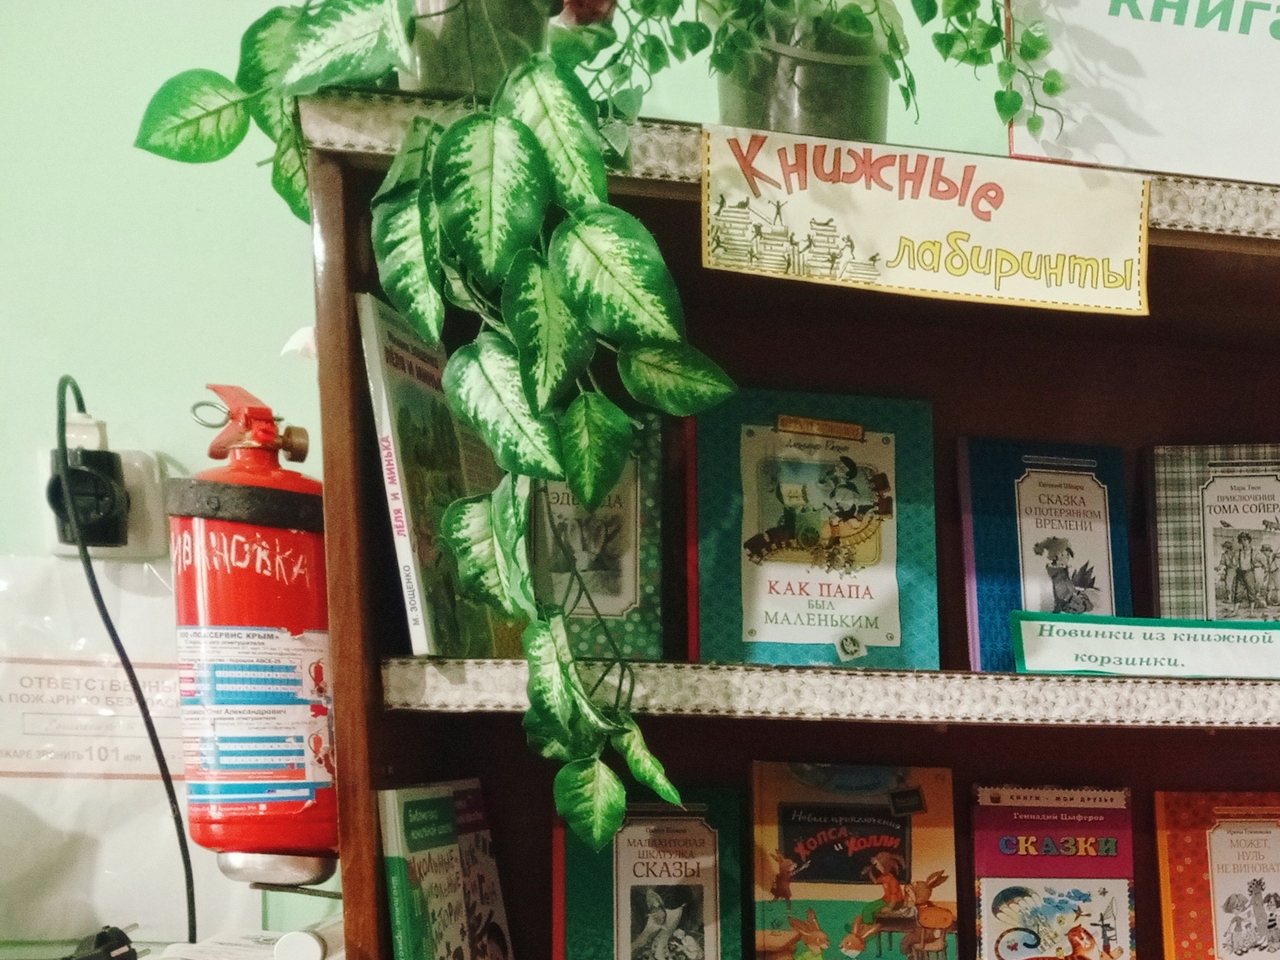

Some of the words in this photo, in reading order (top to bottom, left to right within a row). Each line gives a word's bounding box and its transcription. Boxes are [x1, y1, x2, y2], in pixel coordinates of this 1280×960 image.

[726, 133, 1005, 222] Книжные
[885, 230, 1135, 291] лабиринты
[380, 435, 398, 485] МИНЬКА
[391, 492, 400, 501] И
[1038, 494, 1086, 507] СКАЗКА
[1216, 494, 1275, 502] ПРИКЛЮЧЕНИЯ
[1025, 507, 1032, 515] О
[1034, 507, 1102, 519] ПОТЕРЯННОМ
[1206, 504, 1240, 515] ТОМА
[392, 508, 407, 537] ЛЁЛЯ
[1035, 519, 1093, 531] ВРЕМЕНИ
[403, 564, 419, 612] ЗОЩЕНКО
[767, 579, 811, 598] КАК
[818, 582, 874, 600] ПАПА
[807, 600, 835, 612] БЫЛ
[763, 610, 880, 630] МАЛЕНЬКИМ
[1037, 623, 1136, 641] Новинки
[1142, 629, 1166, 641] из
[1172, 629, 1275, 645] книжной
[1073, 652, 1186, 669] корзинки.
[86, 746, 120, 762] 101
[1014, 813, 1058, 821] Геннадий
[999, 836, 1118, 857] СКАЗКИ
[1230, 839, 1270, 849] МОЖЕТ,
[1238, 851, 1265, 860] НУЛЬ
[633, 861, 700, 877] СКАЗЫ
[1217, 864, 1230, 873] НЕ
